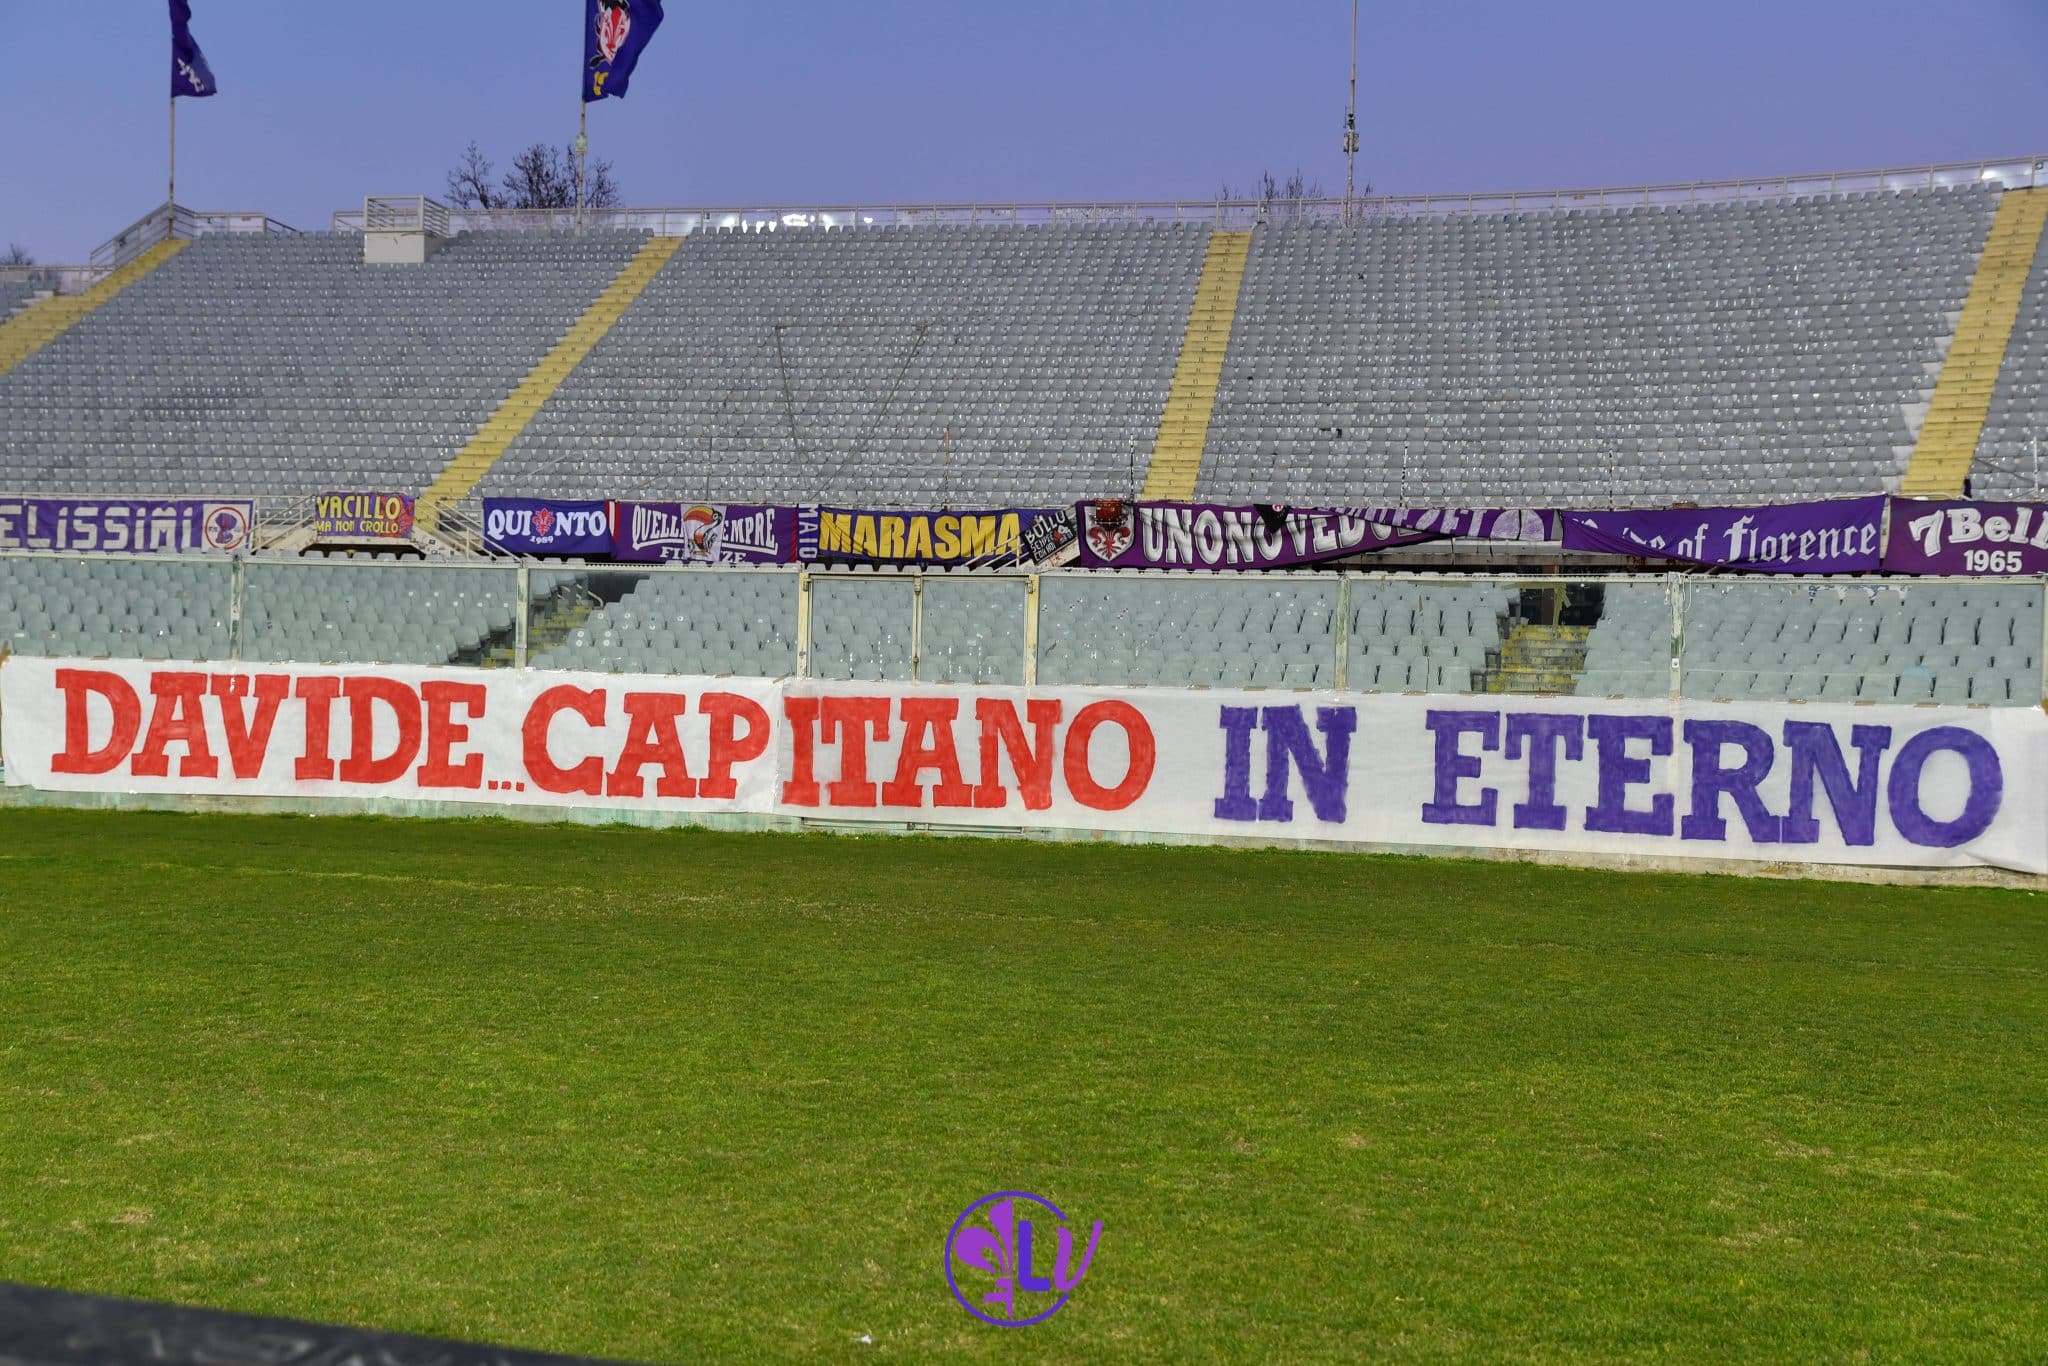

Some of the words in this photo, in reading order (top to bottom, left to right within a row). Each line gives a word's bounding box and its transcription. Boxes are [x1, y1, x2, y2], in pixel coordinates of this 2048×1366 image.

[316, 496, 401, 520] VACILLO
[316, 520, 332, 532] MA
[335, 521, 355, 532] NON
[360, 521, 399, 534] CROLLO
[819, 511, 1020, 560] MARASMA
[1963, 549, 2023, 573] 1965
[1213, 704, 1357, 824] IN
[1421, 709, 2003, 848] ETERNO
